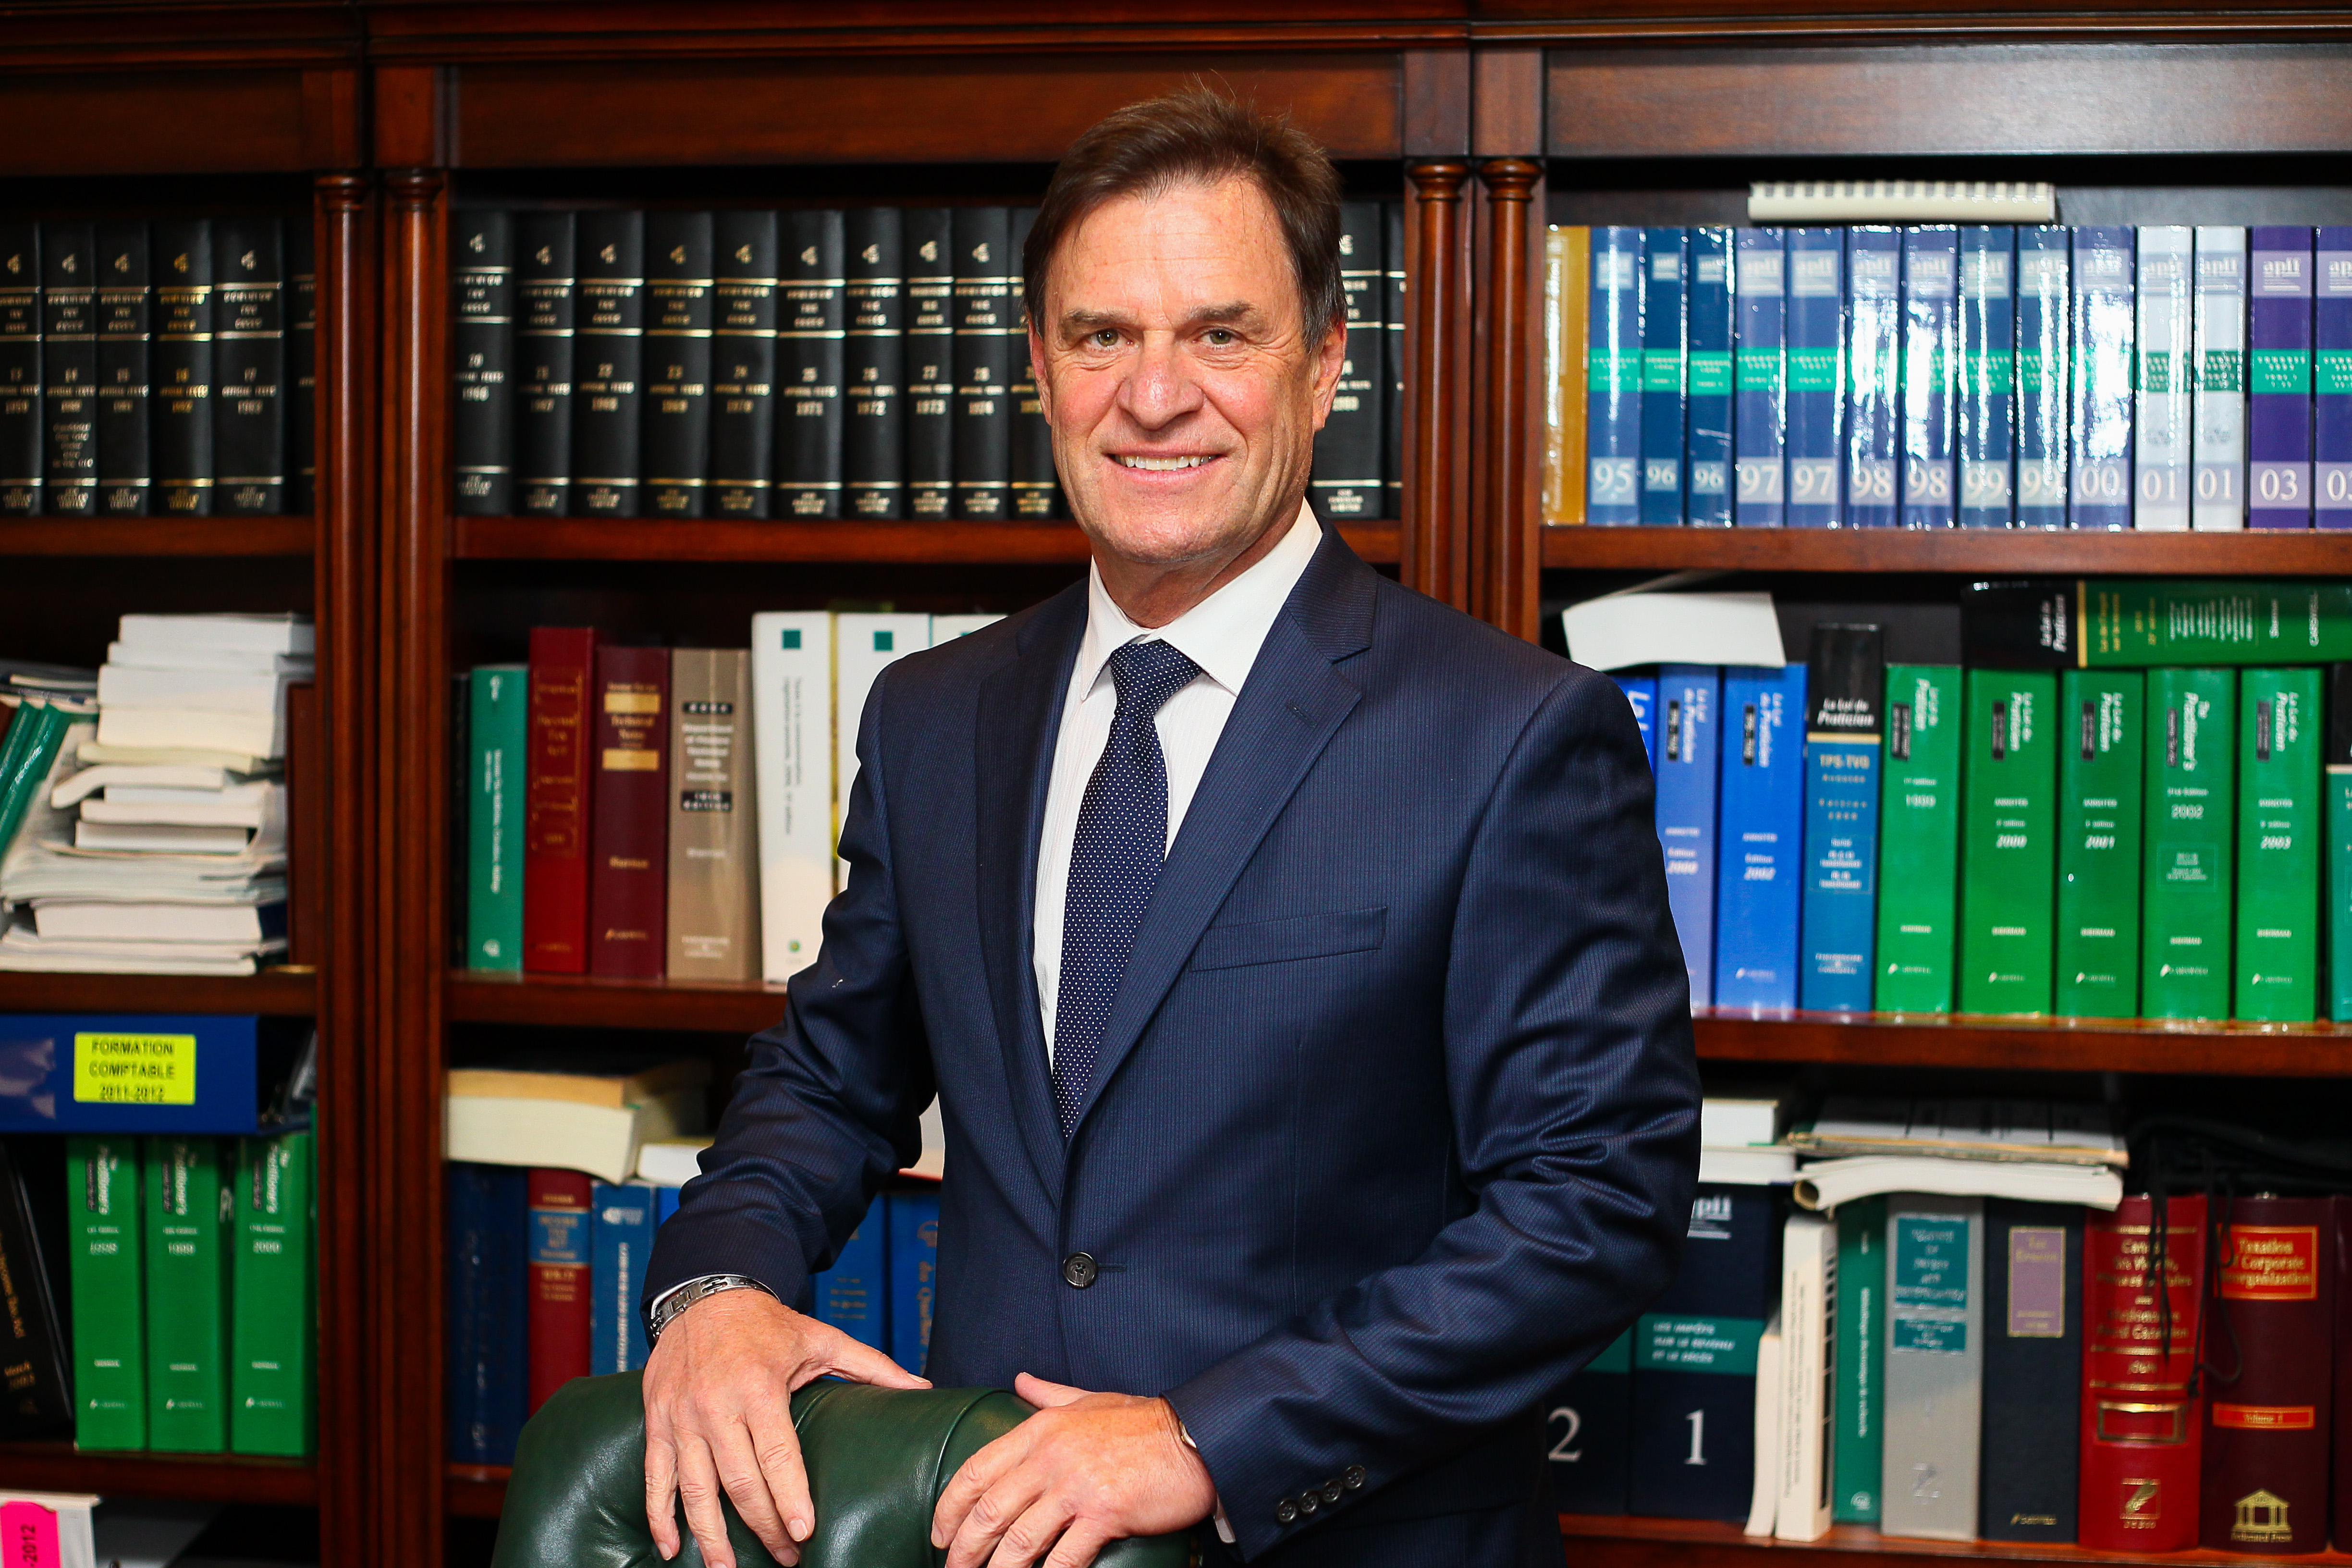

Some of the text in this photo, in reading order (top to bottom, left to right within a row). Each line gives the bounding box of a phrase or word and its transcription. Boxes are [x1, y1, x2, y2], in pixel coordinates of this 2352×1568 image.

[1594, 465, 1631, 495] 95
[1648, 467, 1675, 483] 96
[1694, 470, 1722, 486] 96
[1741, 465, 1778, 495] 97
[1795, 465, 1832, 495] 97
[1853, 465, 1891, 498] 98
[1909, 466, 1946, 498] 98
[1969, 466, 2005, 498] 99
[2024, 466, 2060, 497] 99
[2081, 466, 2119, 497] 00
[2142, 469, 2175, 501] 01
[2198, 468, 2231, 501] 01
[2260, 468, 2298, 501] 03
[1817, 712, 1875, 727] Praticien
[2171, 804, 2204, 819] 2002
[1996, 834, 2028, 849] 2000
[2085, 835, 2115, 849] 2001
[2260, 835, 2291, 850] 2003
[91, 1038, 174, 1055] FORMATION
[88, 1063, 175, 1079] COMPTABLE
[100, 1085, 166, 1101] 2011-2012
[2236, 1238, 2293, 1254] Taxation
[2241, 1255, 2305, 1273] Corporate
[1547, 1407, 1582, 1462] 2
[1685, 1410, 1707, 1466] 1
[21, 1523, 36, 1568] -2012
